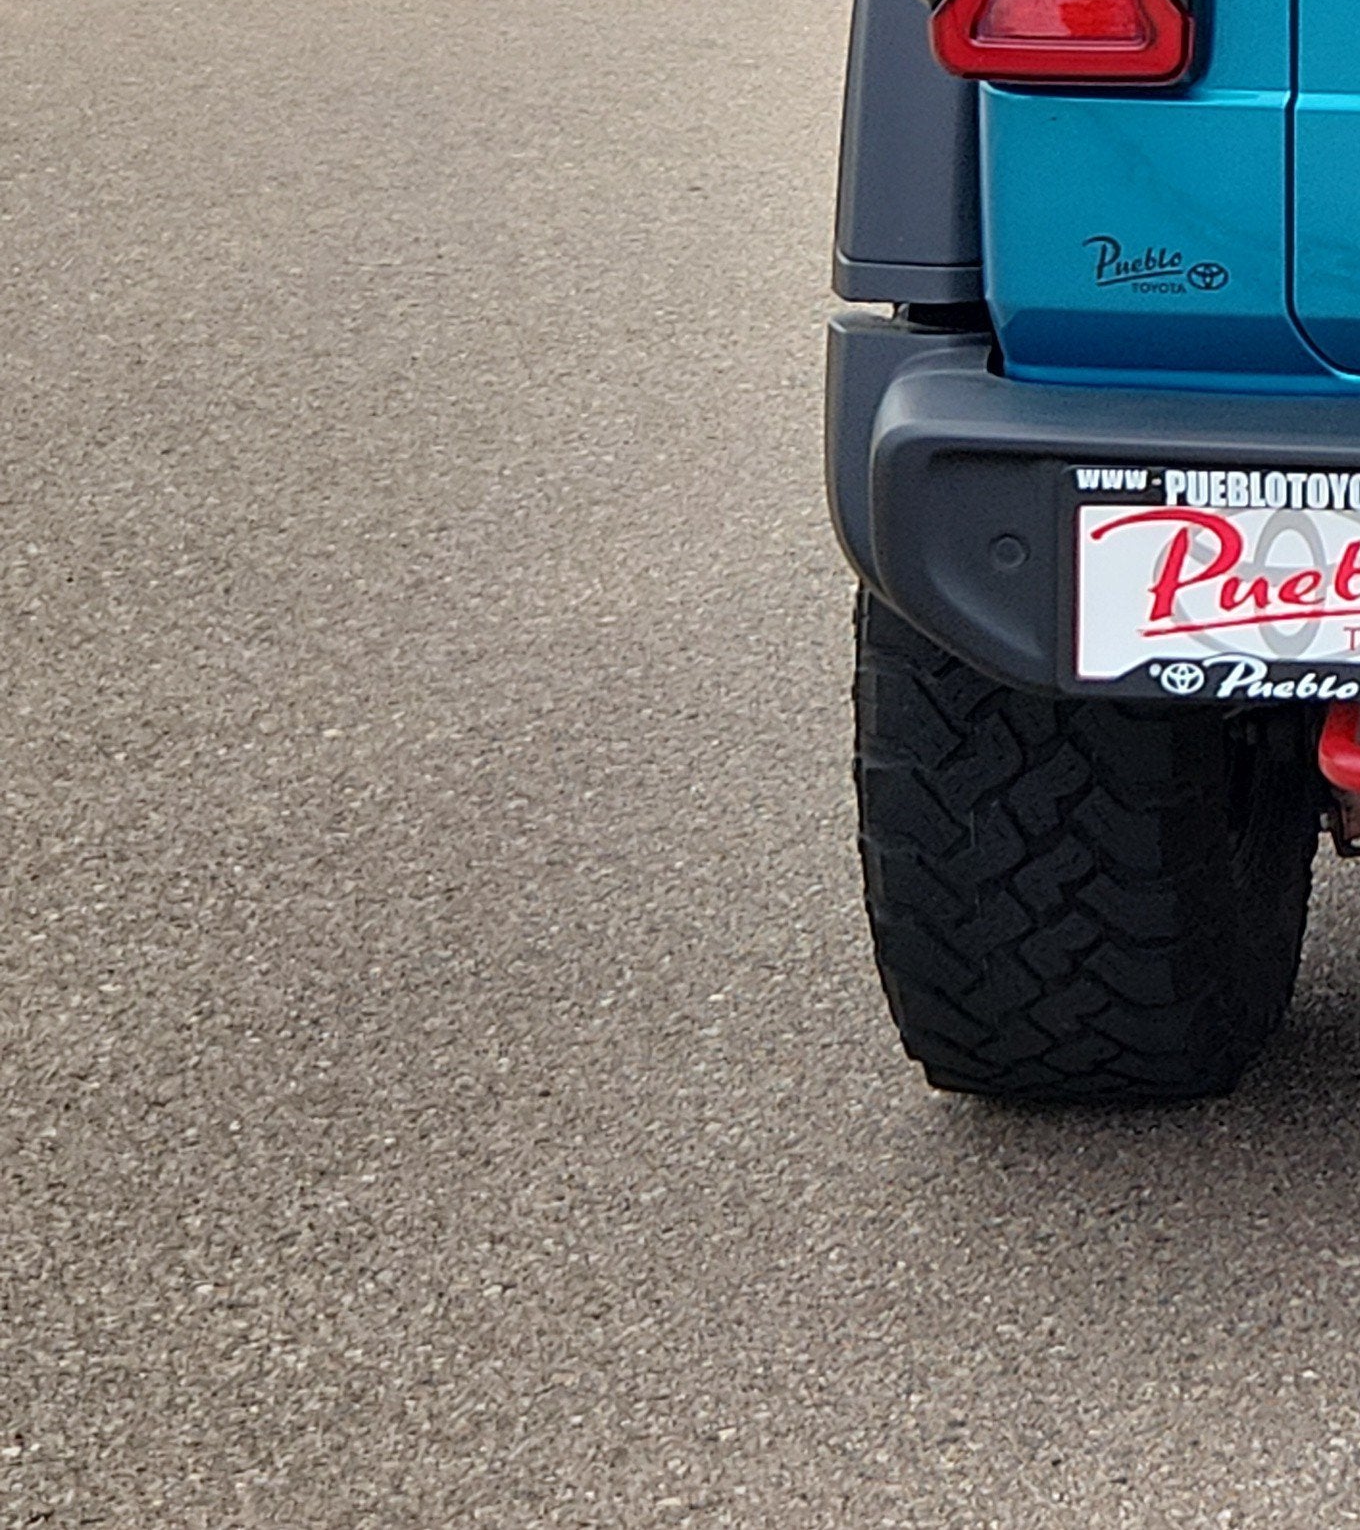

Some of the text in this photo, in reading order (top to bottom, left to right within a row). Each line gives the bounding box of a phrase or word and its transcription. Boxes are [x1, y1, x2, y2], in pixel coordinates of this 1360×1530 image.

[1082, 235, 1183, 280] Pueblo
[1131, 282, 1188, 294] TOYOTA
[1202, 655, 1360, 700] Pueblo
